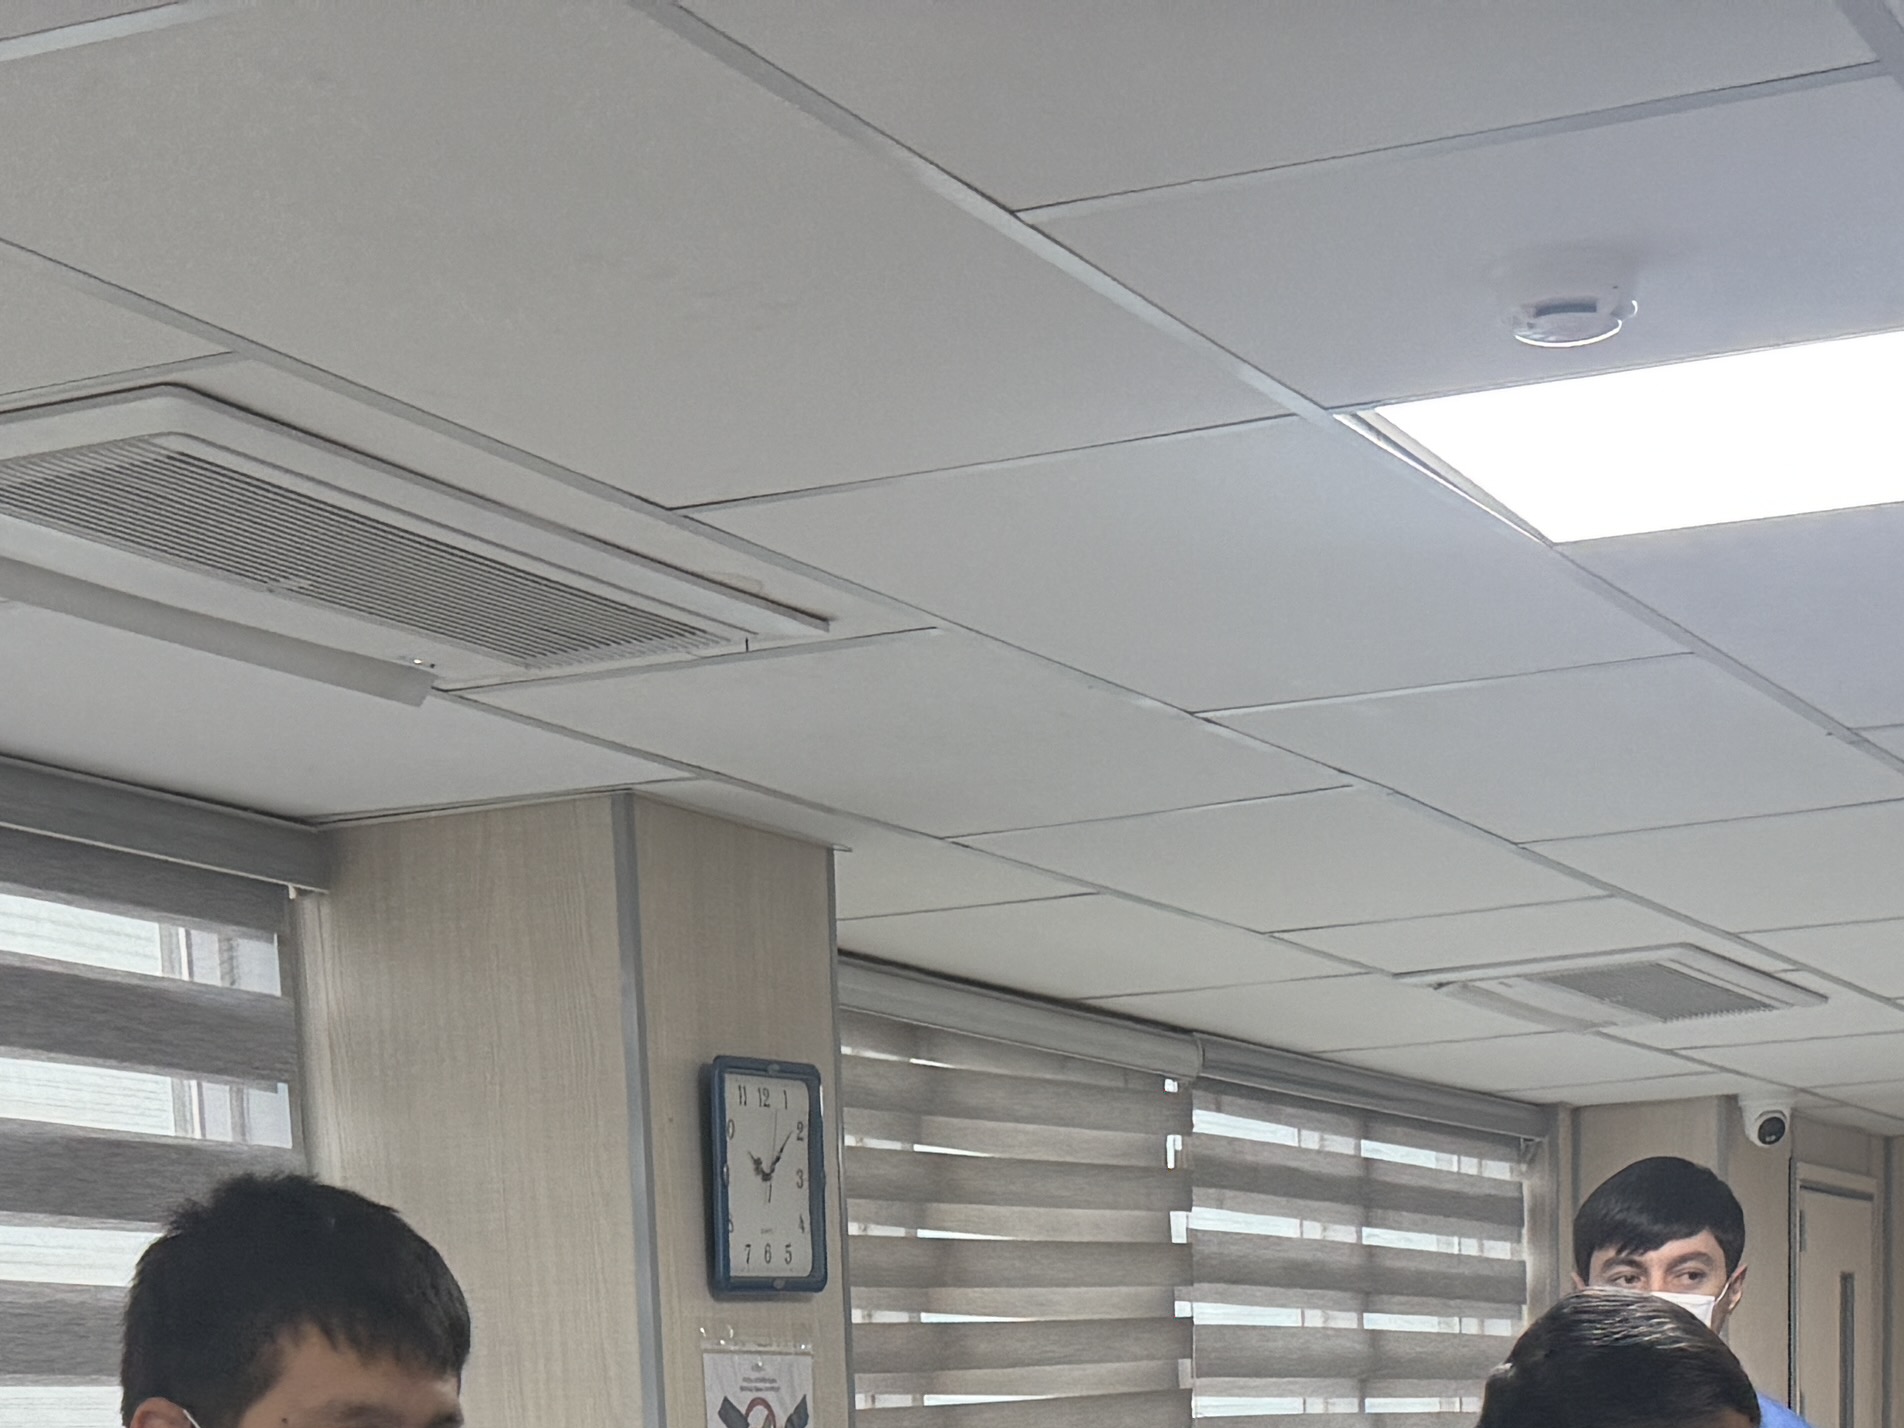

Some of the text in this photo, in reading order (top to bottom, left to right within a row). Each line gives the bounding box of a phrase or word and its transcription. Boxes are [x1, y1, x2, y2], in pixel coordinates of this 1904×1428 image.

[738, 1085, 788, 1110] 11 12 1
[796, 1121, 805, 1142] 2
[796, 1169, 805, 1190] 3
[799, 1214, 806, 1235] 4
[745, 1242, 793, 1265] 7 6 5
